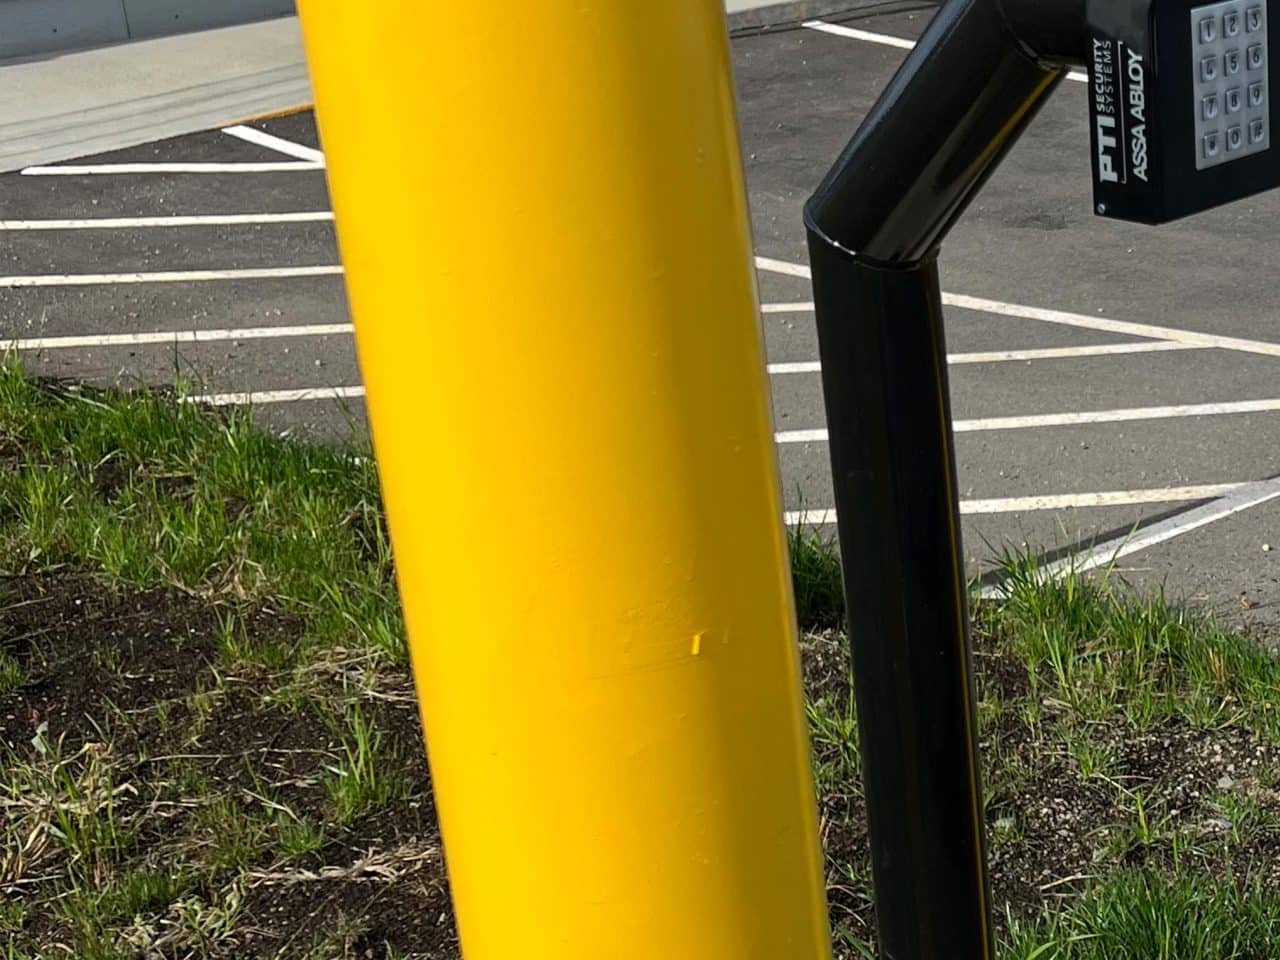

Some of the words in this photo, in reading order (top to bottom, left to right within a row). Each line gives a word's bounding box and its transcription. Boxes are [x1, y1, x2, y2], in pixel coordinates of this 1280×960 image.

[1093, 38, 1106, 113] SECURITY
[1102, 40, 1115, 114] SYSTEMS
[1127, 47, 1145, 122] ABLOY
[1097, 115, 1118, 183] PTI
[1131, 124, 1148, 182] ASSA
